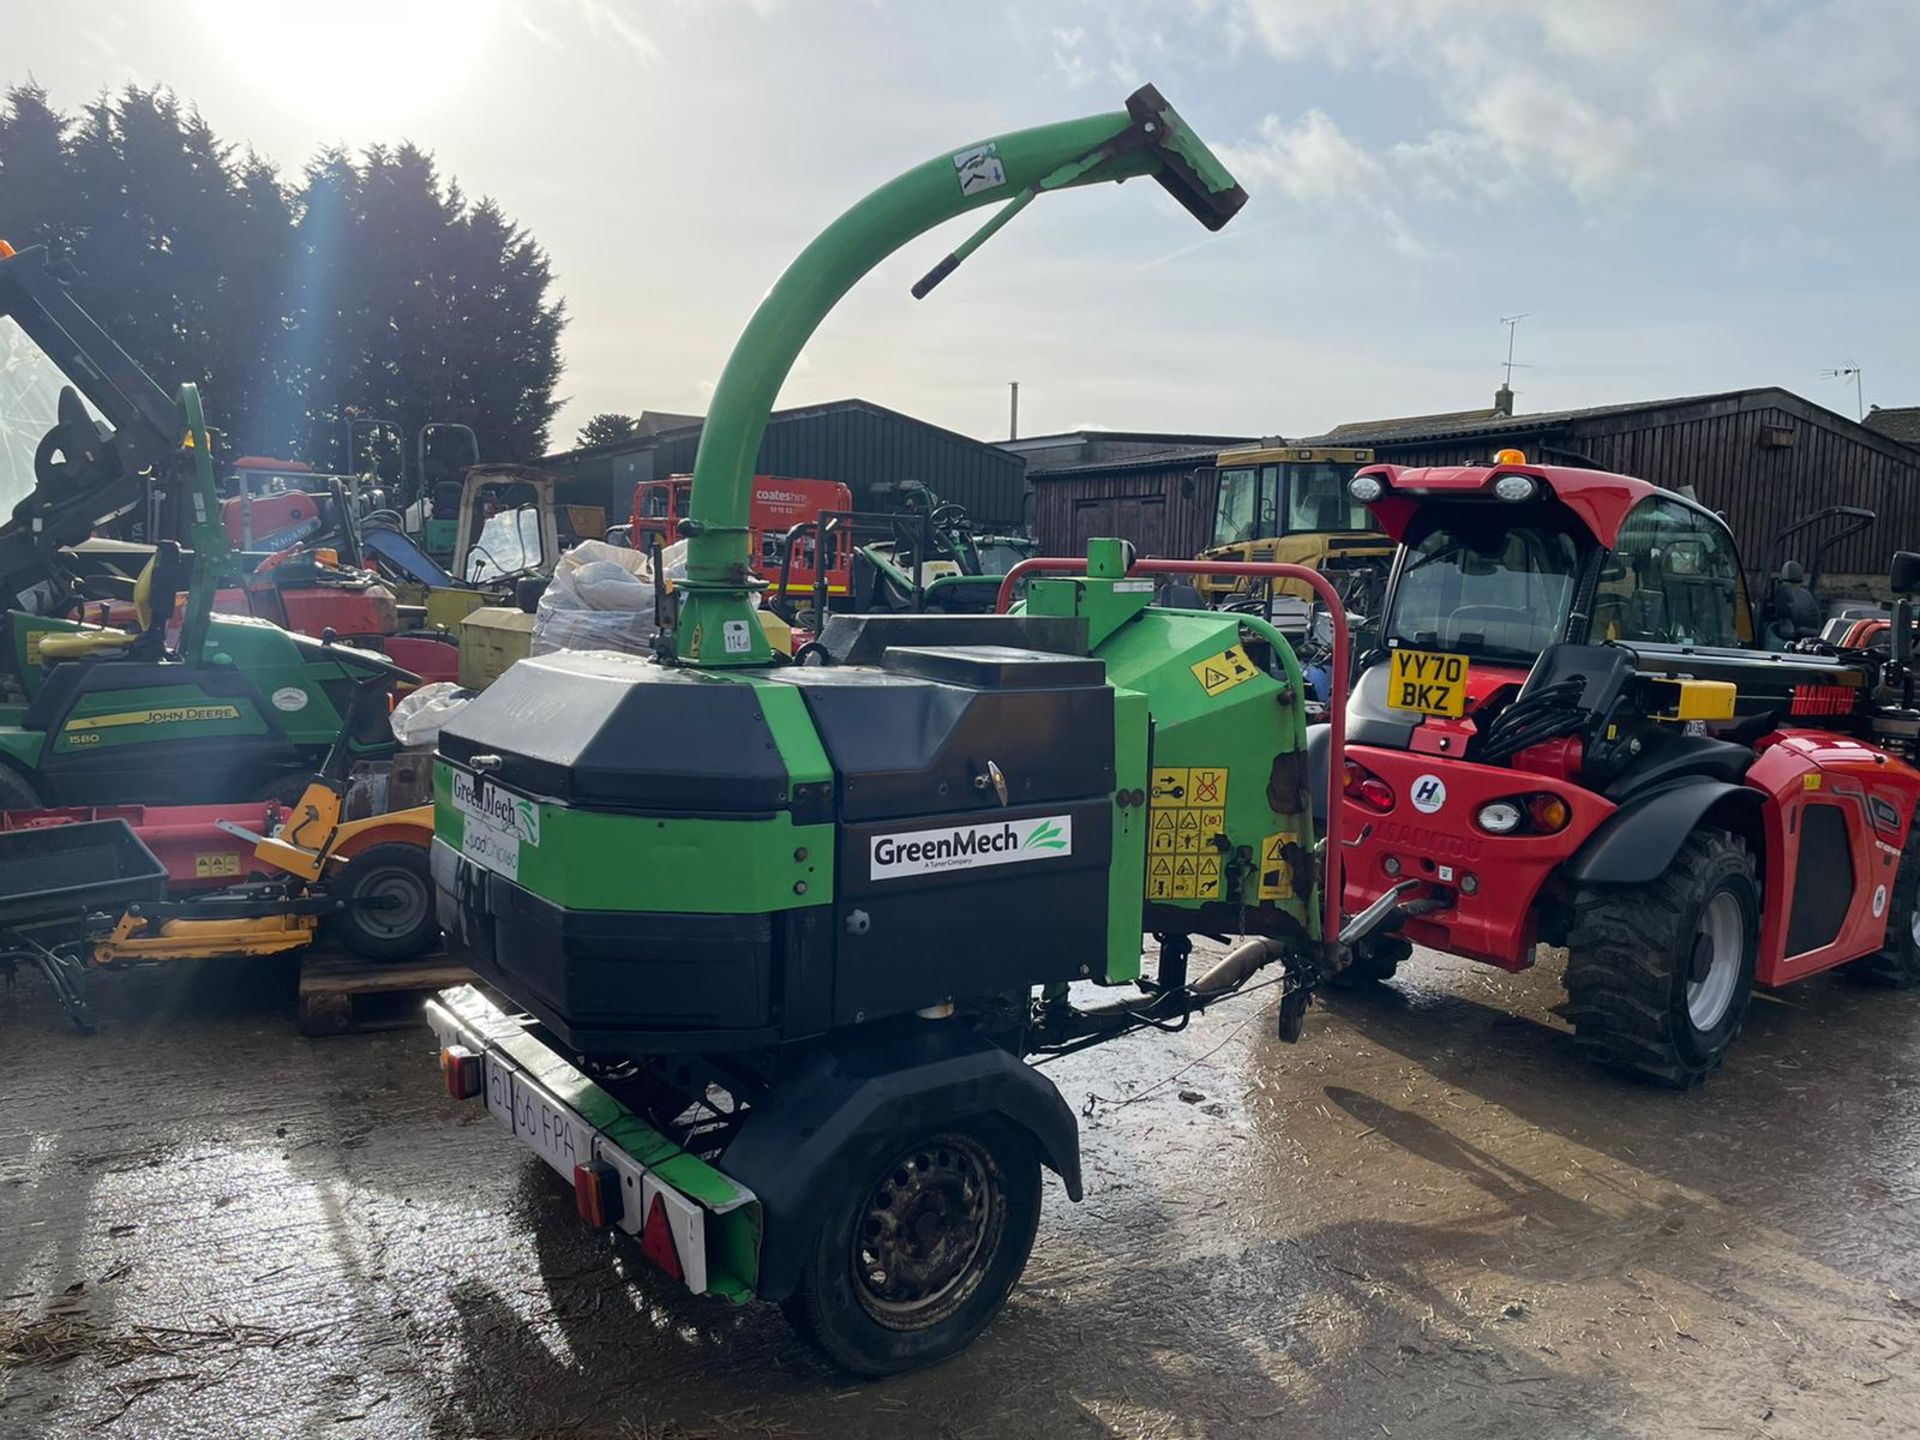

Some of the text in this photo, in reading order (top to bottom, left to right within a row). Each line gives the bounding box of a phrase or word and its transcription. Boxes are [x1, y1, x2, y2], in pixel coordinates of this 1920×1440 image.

[1399, 653, 1462, 682] YY70
[1401, 682, 1450, 711] BKZ
[1791, 685, 1855, 715] MANITOU
[144, 708, 234, 724] JOHN DEERE
[69, 734, 100, 744] 1580
[454, 773, 516, 825] GreenMech
[874, 823, 1018, 865] GreenMech
[1376, 820, 1483, 863] MANITOU
[541, 1104, 576, 1167] FPA
